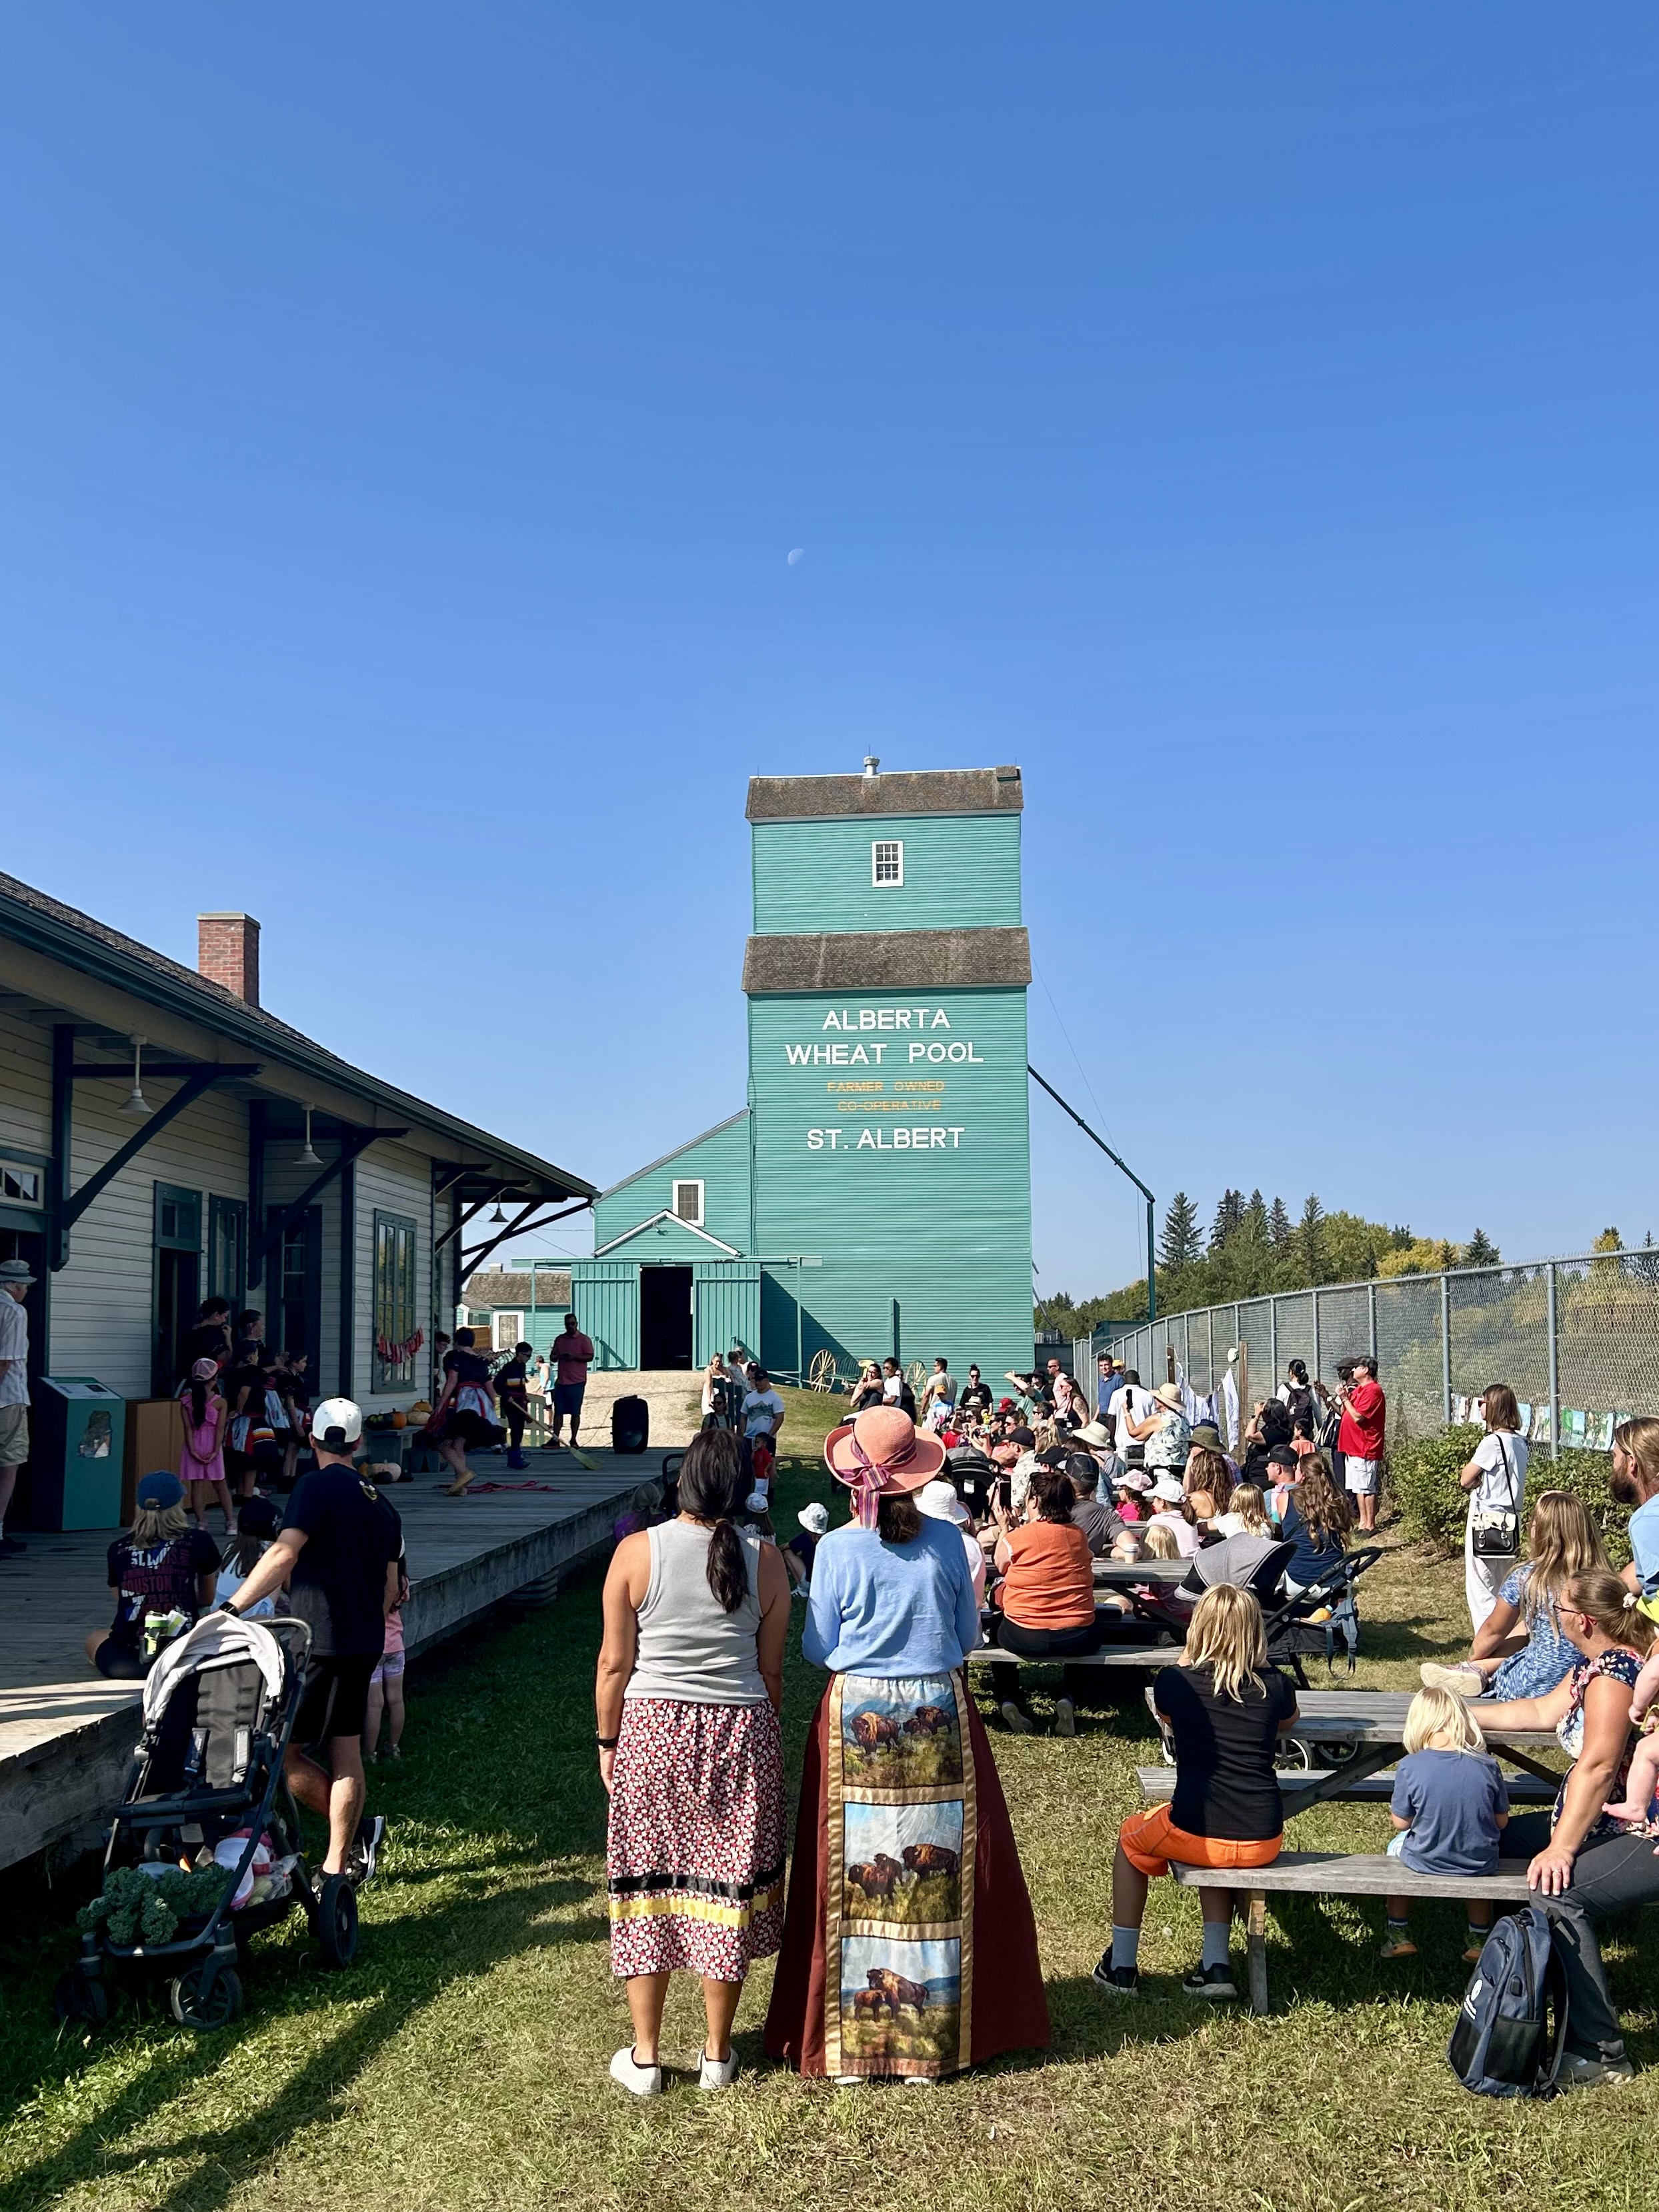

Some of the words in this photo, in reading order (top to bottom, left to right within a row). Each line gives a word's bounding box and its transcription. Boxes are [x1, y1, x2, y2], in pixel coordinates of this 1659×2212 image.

[821, 1008, 951, 1030] ALBERTA
[785, 1043, 888, 1065] WHEAT
[908, 1042, 984, 1064] POOL
[827, 1082, 884, 1092] FARMER
[894, 1080, 946, 1092] OWNED
[838, 1100, 942, 1112] CO-OPERATIVE
[807, 1128, 849, 1150] ST.
[856, 1127, 965, 1149] ALBERT
